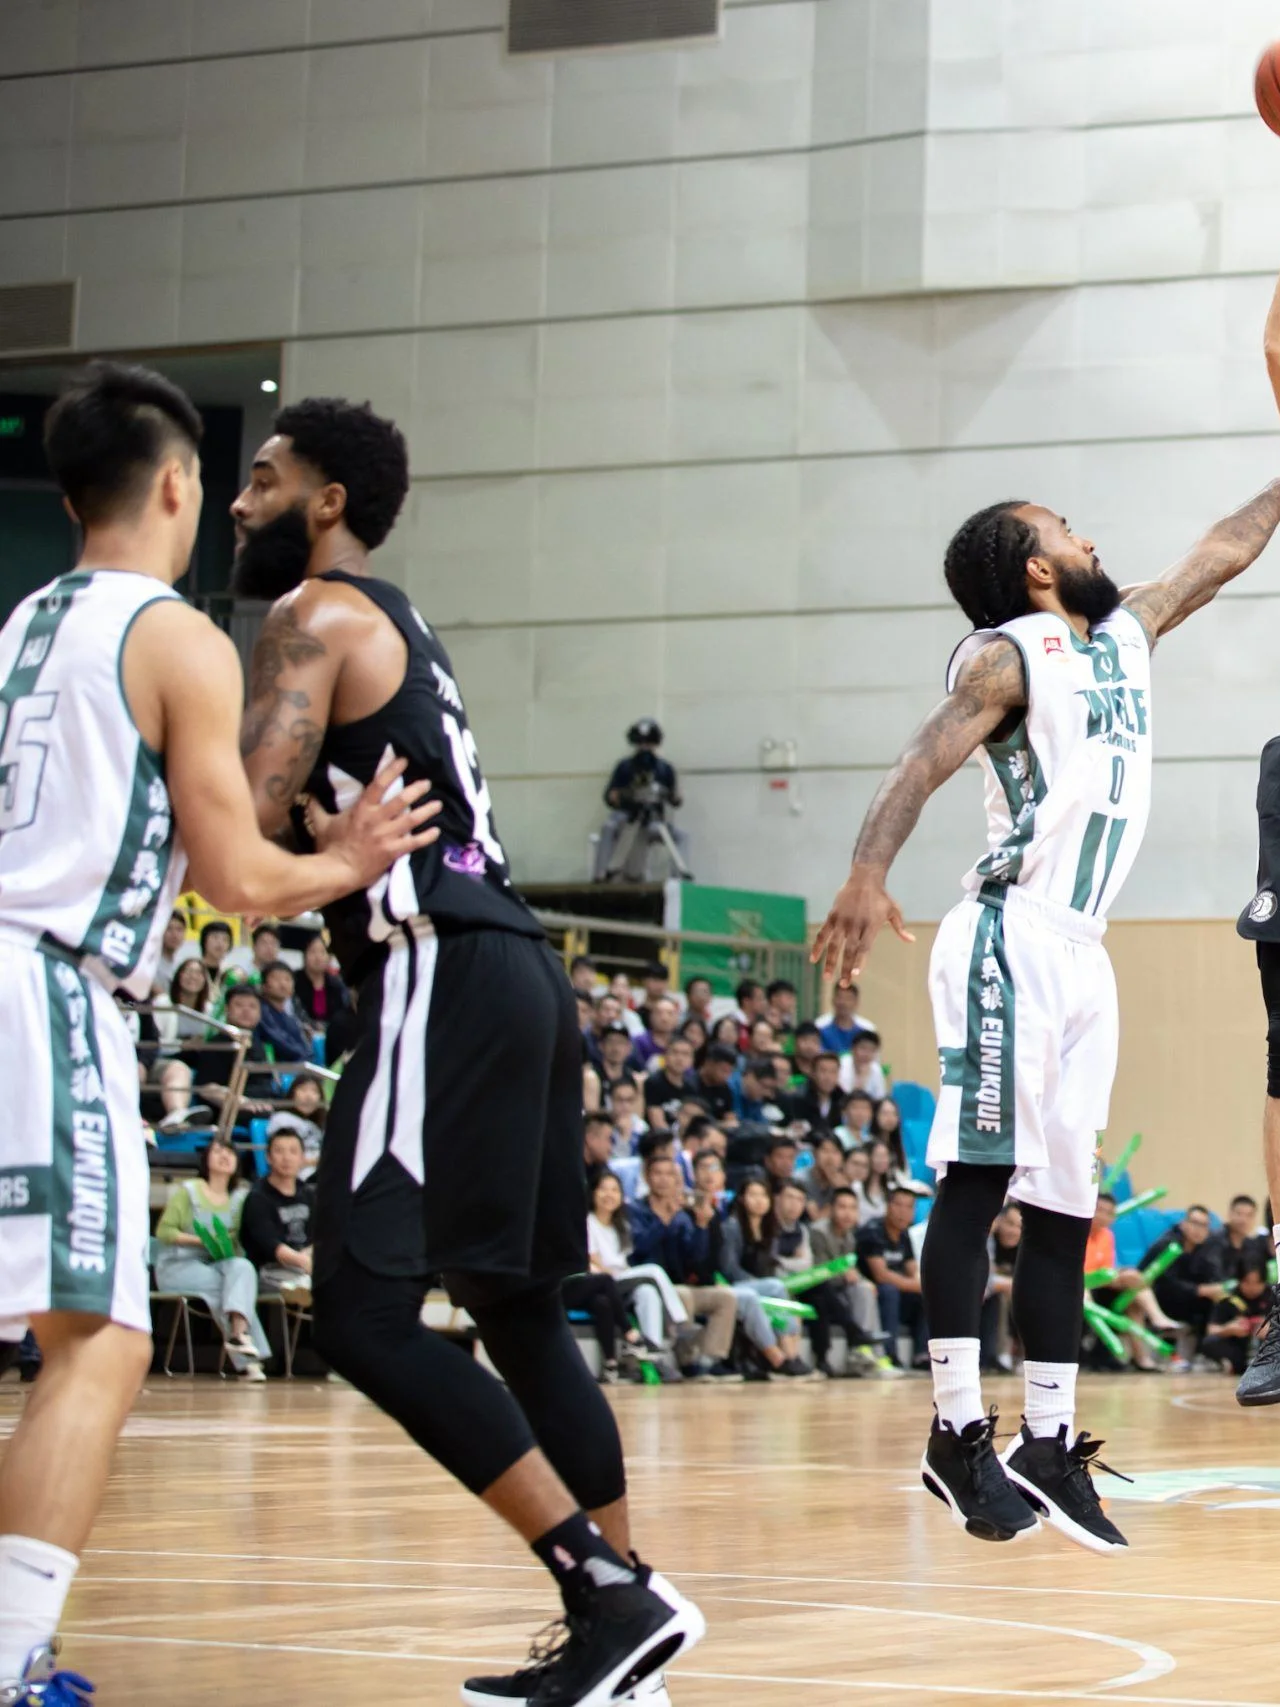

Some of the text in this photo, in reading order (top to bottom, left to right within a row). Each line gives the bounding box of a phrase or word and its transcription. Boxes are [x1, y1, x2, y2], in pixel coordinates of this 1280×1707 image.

[1109, 755, 1125, 805] 0
[976, 1016, 1004, 1134] EUNIKQUE
[68, 1109, 108, 1275] EUNIKQUE
